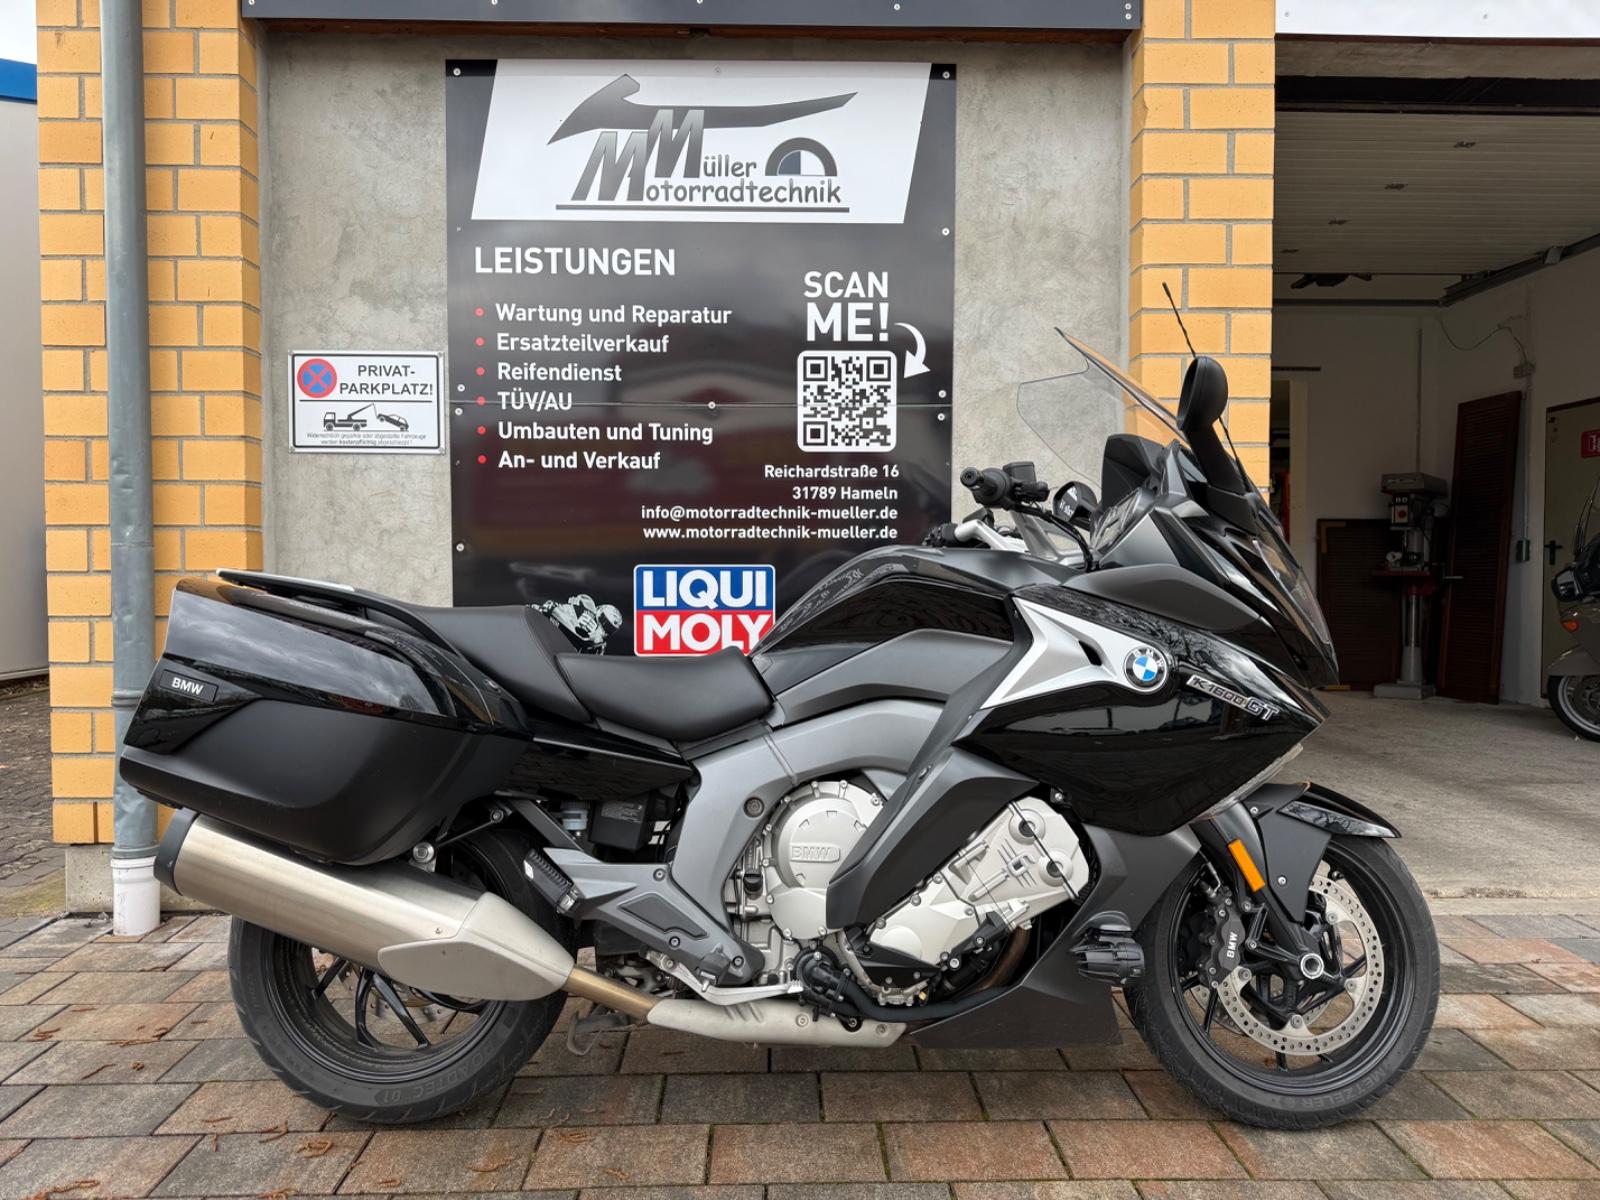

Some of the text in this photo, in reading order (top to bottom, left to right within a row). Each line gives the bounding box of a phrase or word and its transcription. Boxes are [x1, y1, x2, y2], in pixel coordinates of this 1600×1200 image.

[475, 246, 675, 276] LEISTUNGEN
[803, 270, 889, 298] SCAN
[495, 302, 733, 328] Wartung und Reparatur
[806, 301, 890, 342] ME!
[496, 332, 670, 353] Ersatzteilverkauf
[357, 364, 416, 377] PRIVAT-
[497, 361, 622, 382] Reifendienst
[339, 382, 434, 396] PARKPLATZ!
[496, 386, 574, 413] TÜV/AU
[498, 421, 713, 445] Umbauten und Tuning
[498, 450, 661, 470] An- und Verkauf
[762, 463, 900, 479] Reichardstraße 16
[792, 486, 898, 500] 31789 Hameln
[641, 505, 898, 522] info@motorradtechnik-mueller.de
[642, 525, 898, 539] www.motorradtechnik-mueller.de
[642, 568, 768, 611] LIQUI
[642, 613, 773, 653] MOLY
[171, 676, 204, 696] BMW
[1246, 696, 1279, 721] GT
[791, 846, 831, 859] BMW
[1226, 931, 1239, 959] BMW
